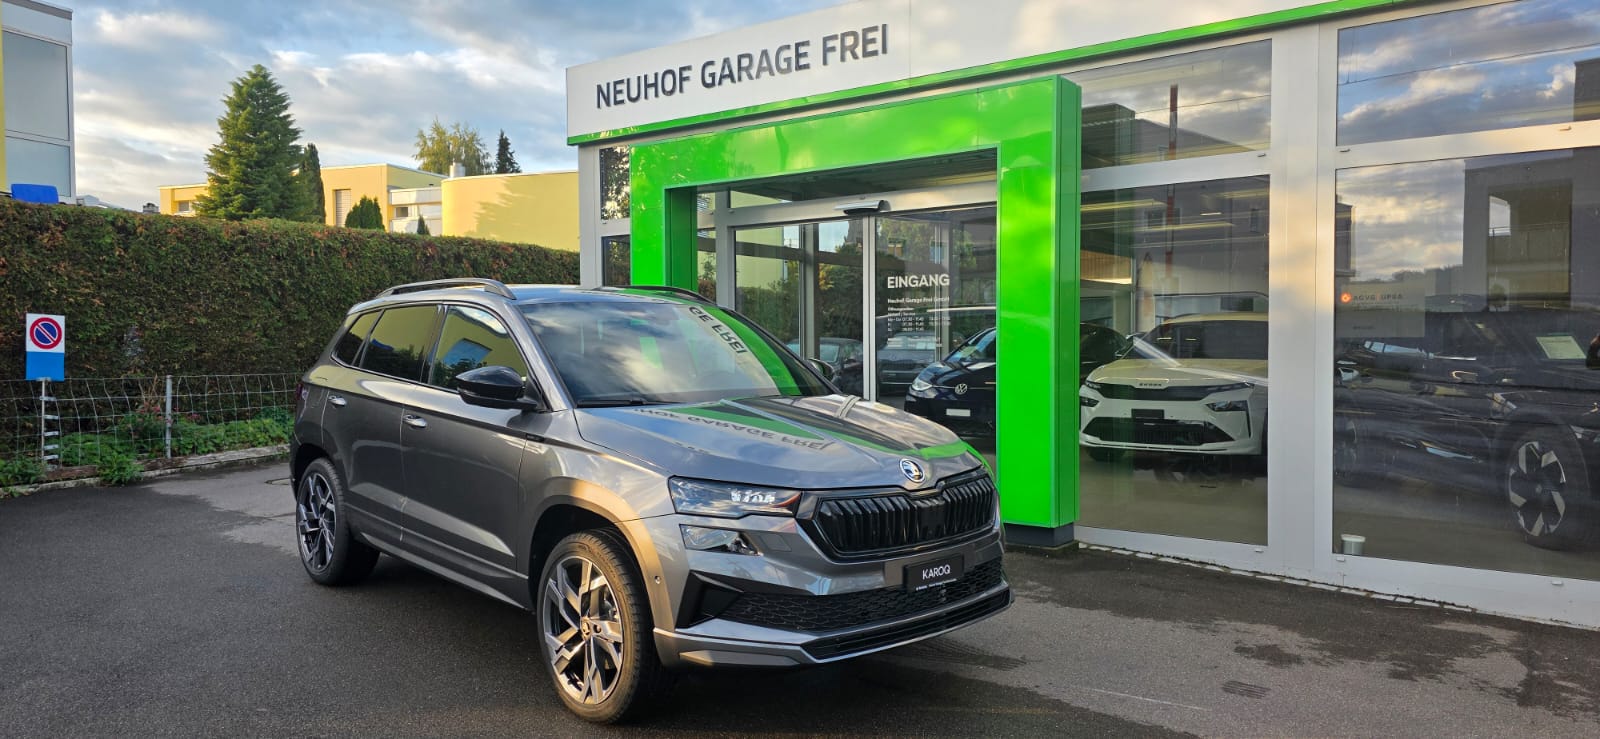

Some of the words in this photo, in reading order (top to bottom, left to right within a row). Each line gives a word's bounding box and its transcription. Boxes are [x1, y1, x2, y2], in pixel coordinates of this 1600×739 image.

[596, 65, 692, 109] NEUHOF
[700, 40, 811, 88] GARAGE
[821, 23, 889, 66] FREI
[887, 273, 949, 289] EINGANG
[922, 564, 951, 580] KAROQ
